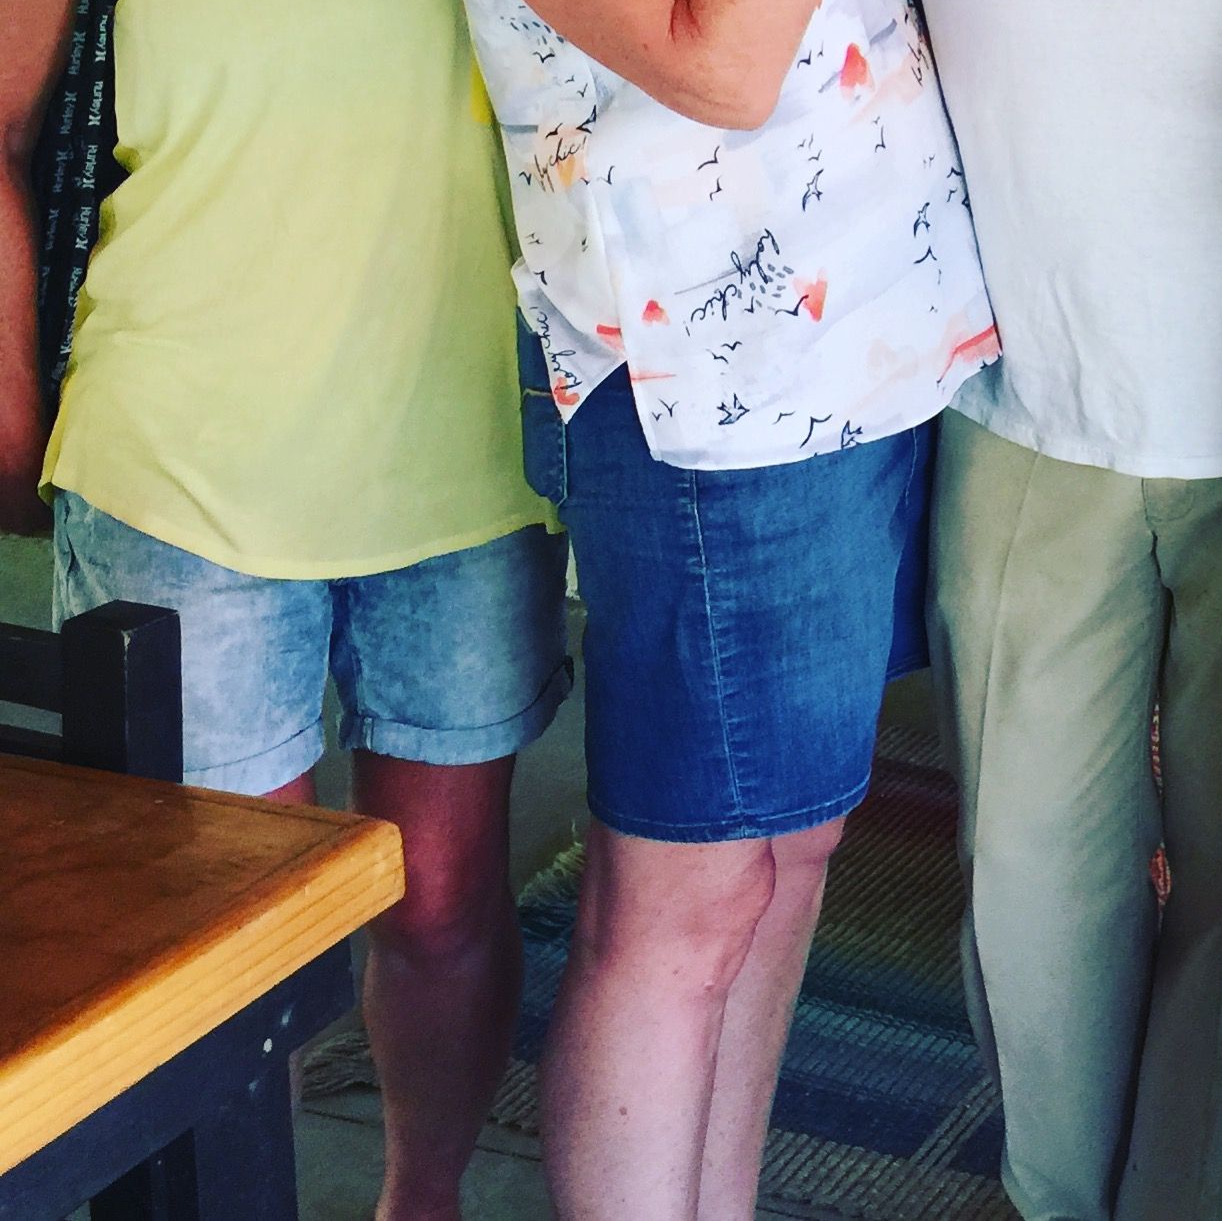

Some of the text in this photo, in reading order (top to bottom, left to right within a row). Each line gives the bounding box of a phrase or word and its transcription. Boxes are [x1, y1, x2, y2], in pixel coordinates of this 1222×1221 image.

[89, 80, 104, 115] Hurley
[82, 145, 98, 178] Hurley
[77, 206, 93, 238] Hurley
[684, 227, 780, 337] holy chic!
